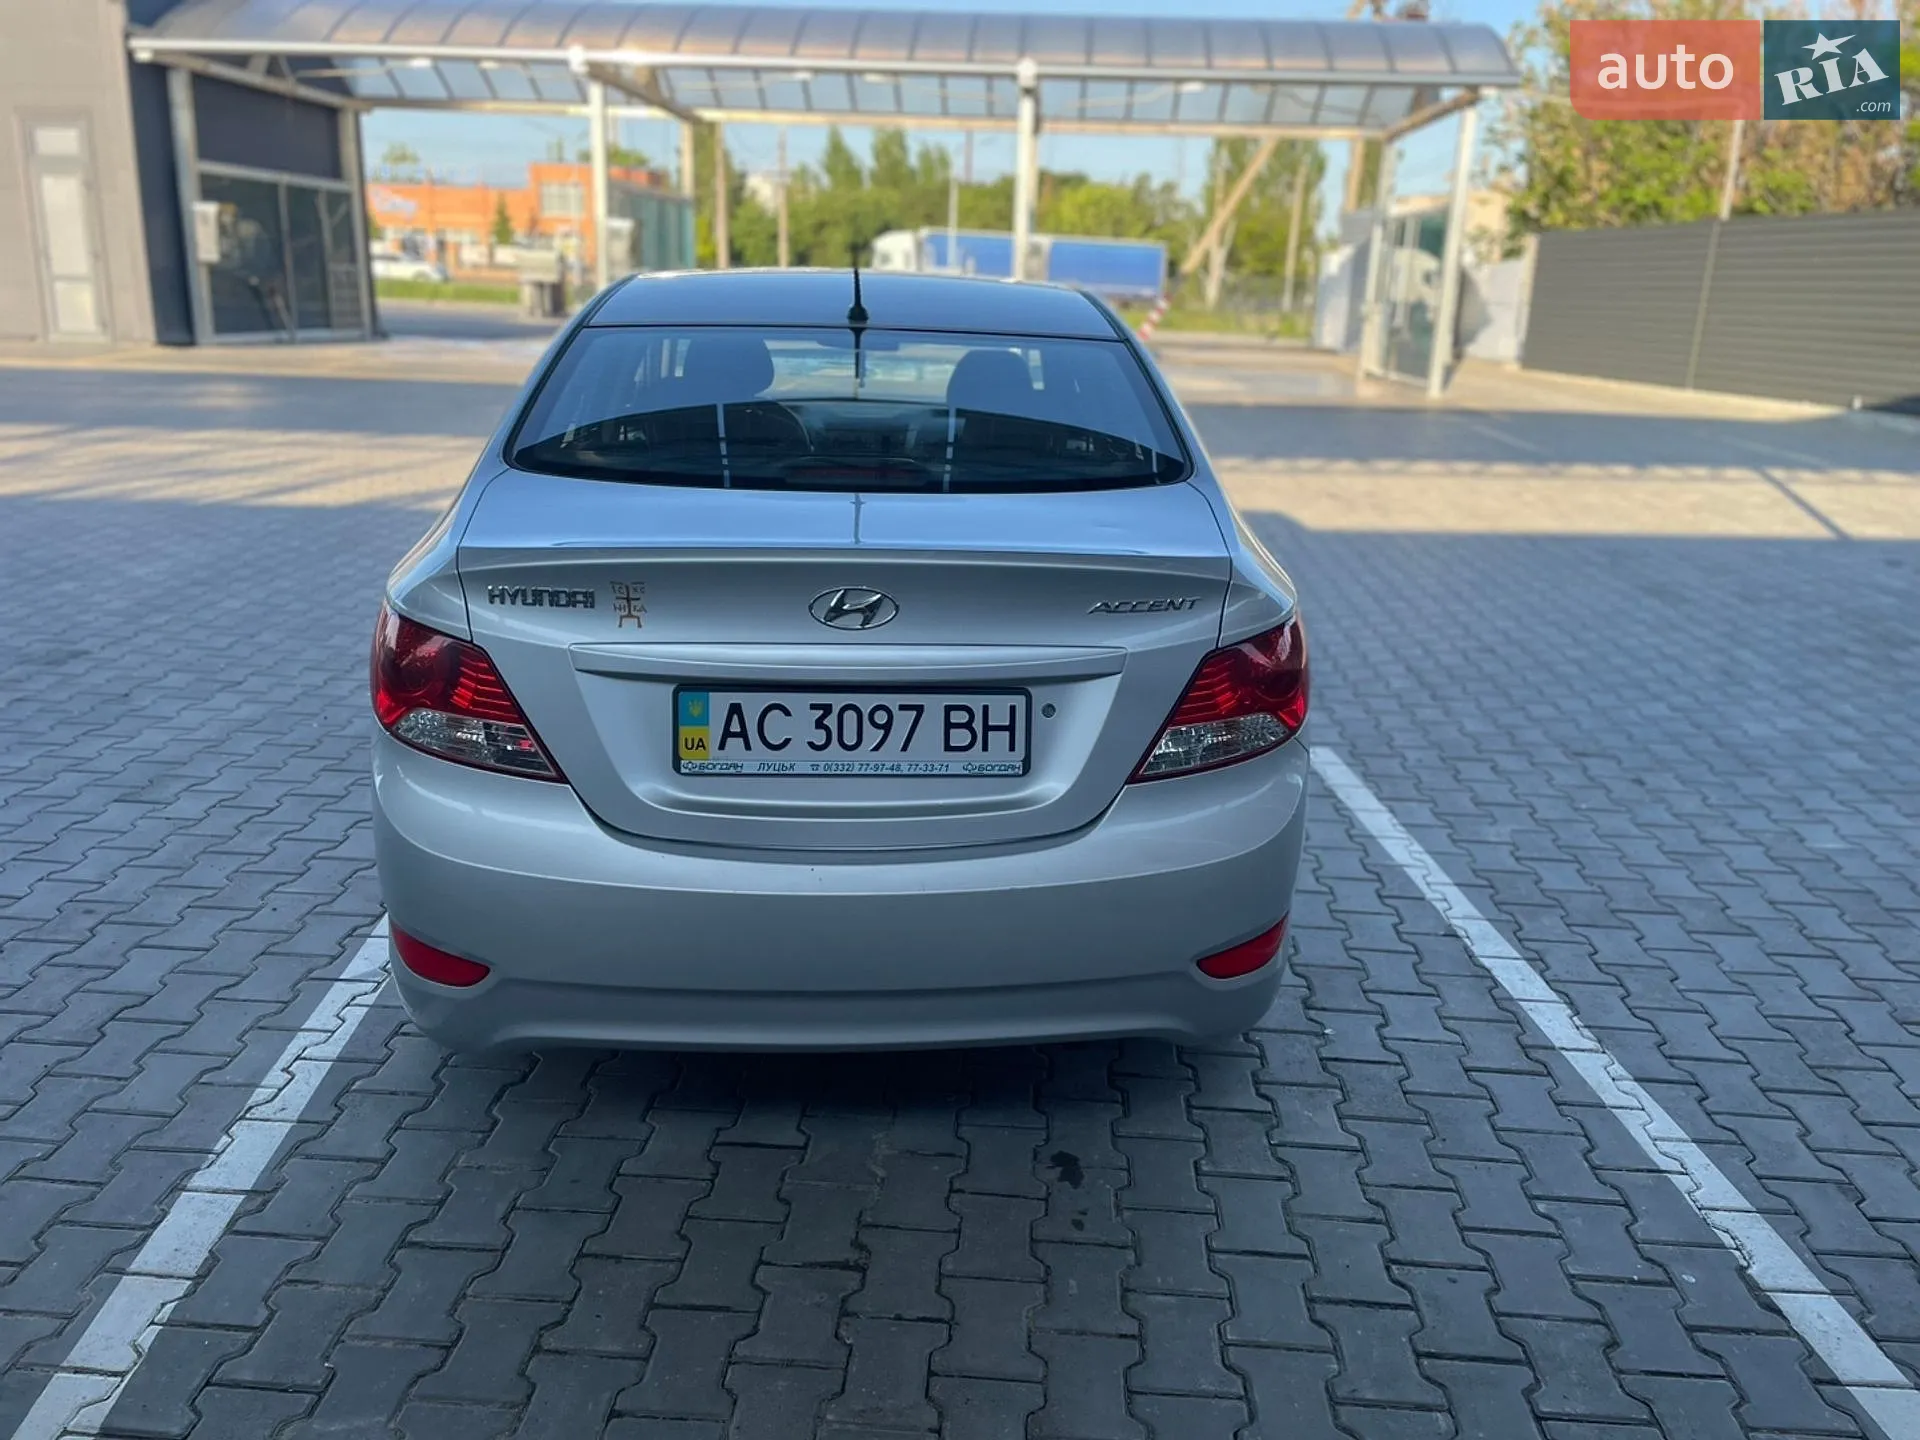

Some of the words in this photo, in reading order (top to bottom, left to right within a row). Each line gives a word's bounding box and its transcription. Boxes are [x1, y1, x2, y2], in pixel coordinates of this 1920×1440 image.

[487, 585, 596, 609] HYUNDAI
[1086, 596, 1202, 615] ACCENT
[717, 702, 793, 752] AC
[806, 702, 925, 752] 3097
[943, 703, 1017, 753] BH
[684, 737, 707, 751] UA
[757, 762, 796, 773] ЛУЦЬК
[822, 762, 855, 773] 0(332)
[907, 762, 949, 773] 77-33-71
